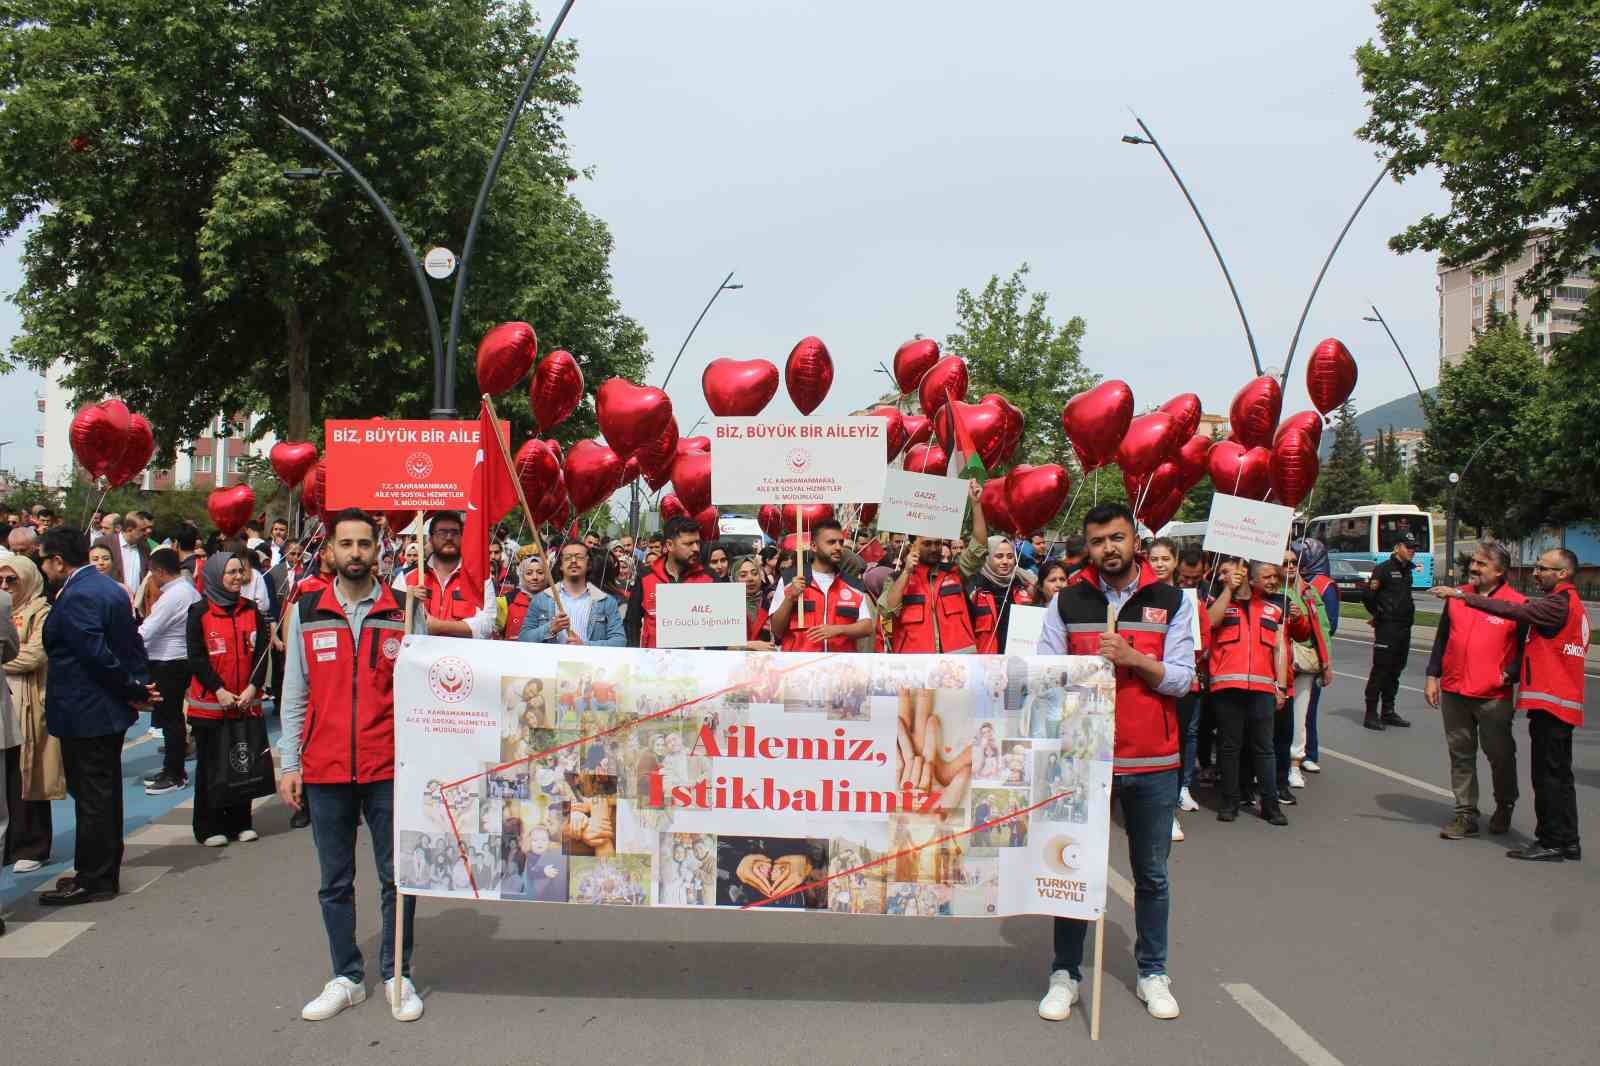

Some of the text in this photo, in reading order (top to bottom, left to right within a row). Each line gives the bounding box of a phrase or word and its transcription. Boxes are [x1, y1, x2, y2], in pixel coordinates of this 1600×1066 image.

[333, 428, 481, 444] BİZ, BÜYÜK BİR AİLE
[716, 423, 880, 439] BİZ, BÜYÜK BİR AİLEYİZ
[806, 484, 842, 492] HİZMETLER
[662, 617, 673, 627] En
[689, 722, 888, 767] Ailemiz,
